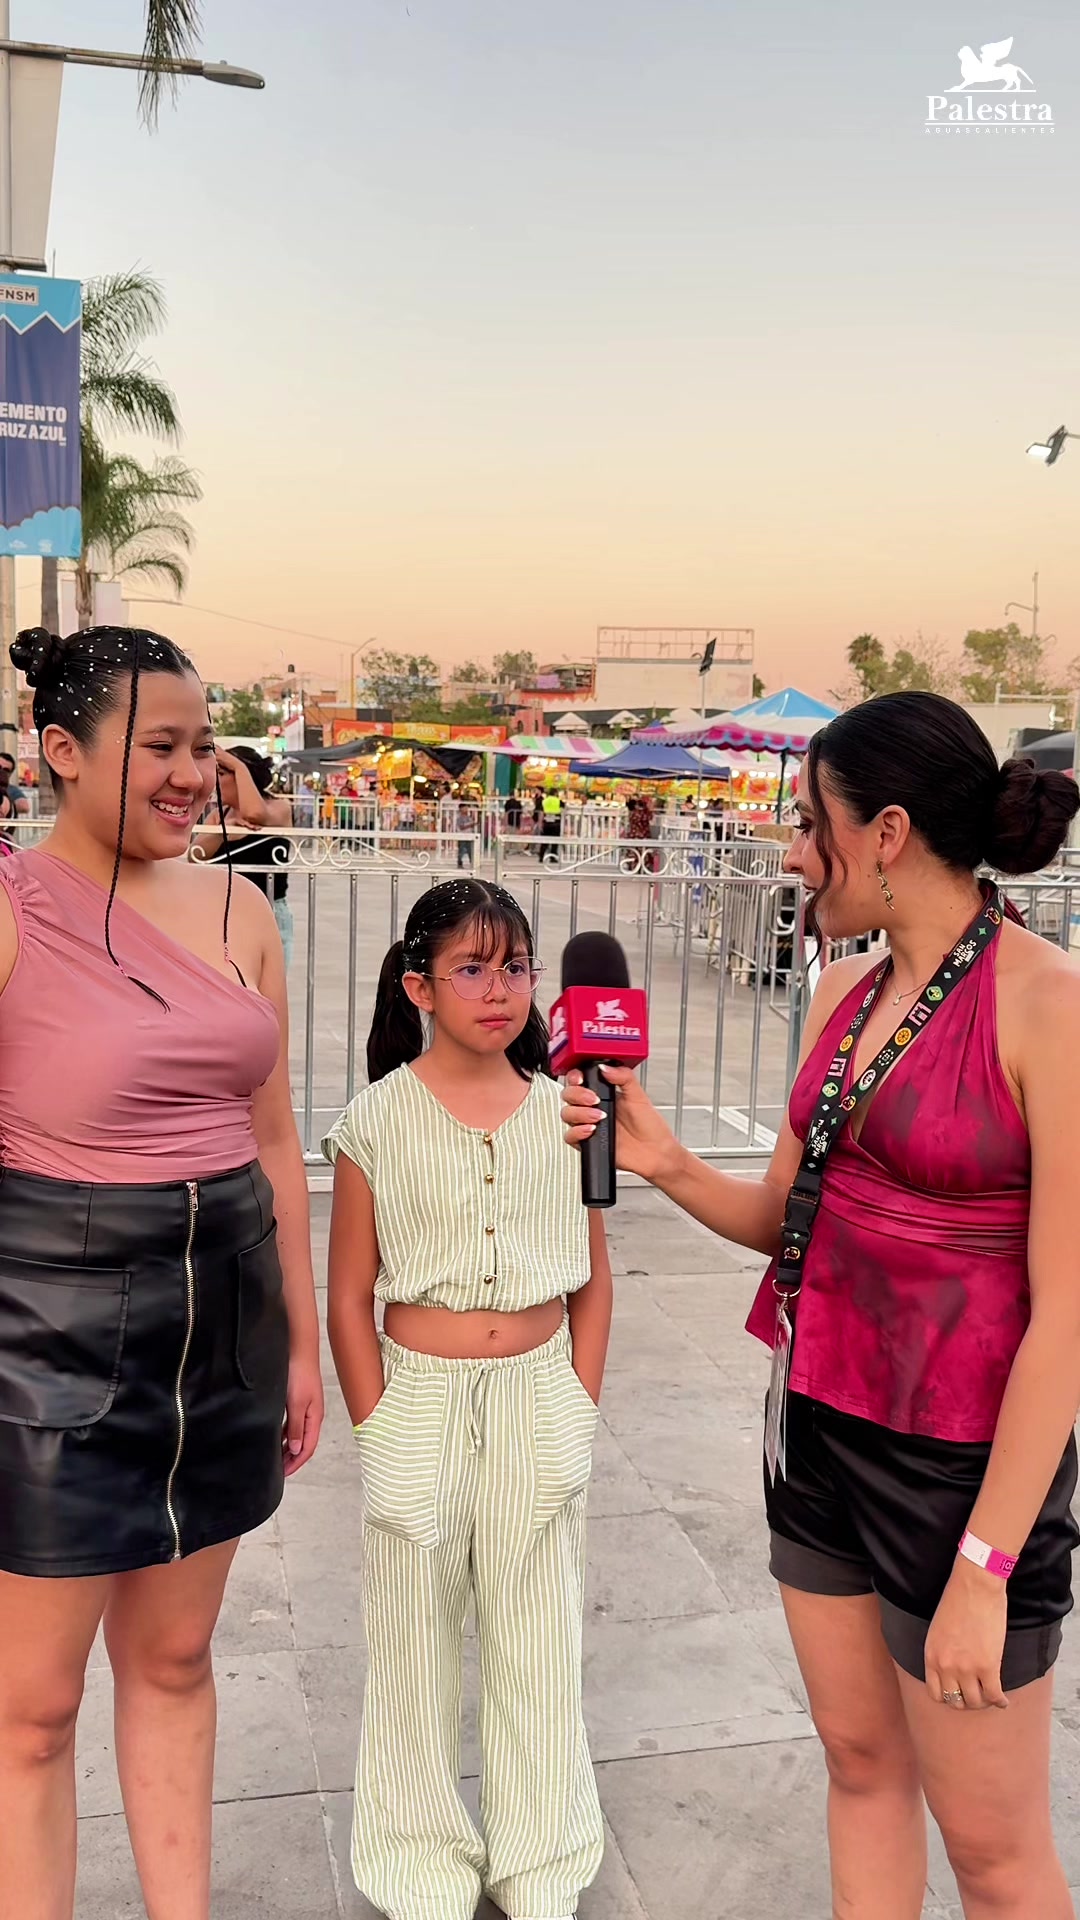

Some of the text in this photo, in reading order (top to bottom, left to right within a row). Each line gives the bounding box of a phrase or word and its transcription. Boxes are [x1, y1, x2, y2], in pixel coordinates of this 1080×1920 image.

[28, 424, 67, 442] AZUL
[952, 939, 977, 968] MARCOS
[953, 943, 966, 957] SAN
[581, 1020, 641, 1036] Palestra
